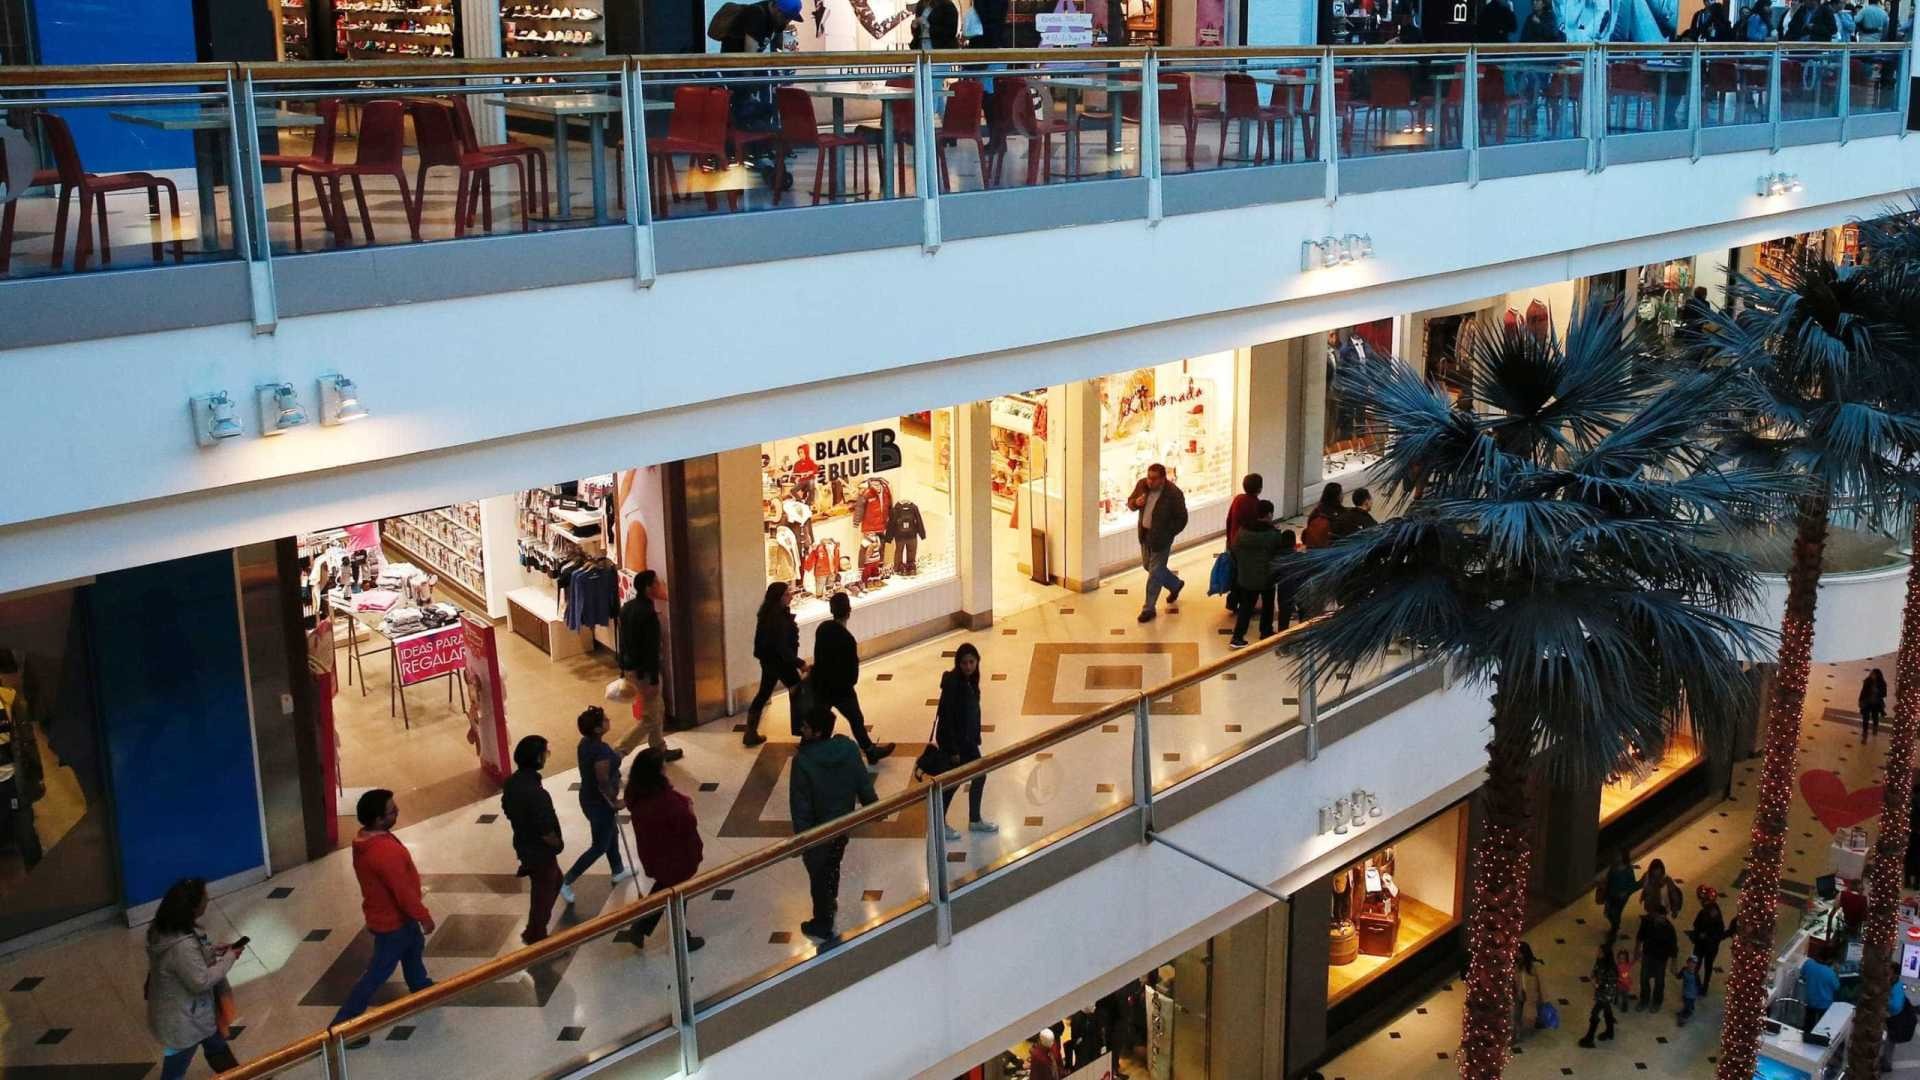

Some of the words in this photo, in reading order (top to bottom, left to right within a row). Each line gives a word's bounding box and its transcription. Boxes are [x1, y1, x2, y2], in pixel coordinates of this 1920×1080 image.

[1454, 0, 1467, 22] B
[816, 432, 870, 461] BLACK
[828, 456, 870, 482] BLUE
[400, 641, 433, 660] IDEAS
[436, 634, 465, 650] PARA
